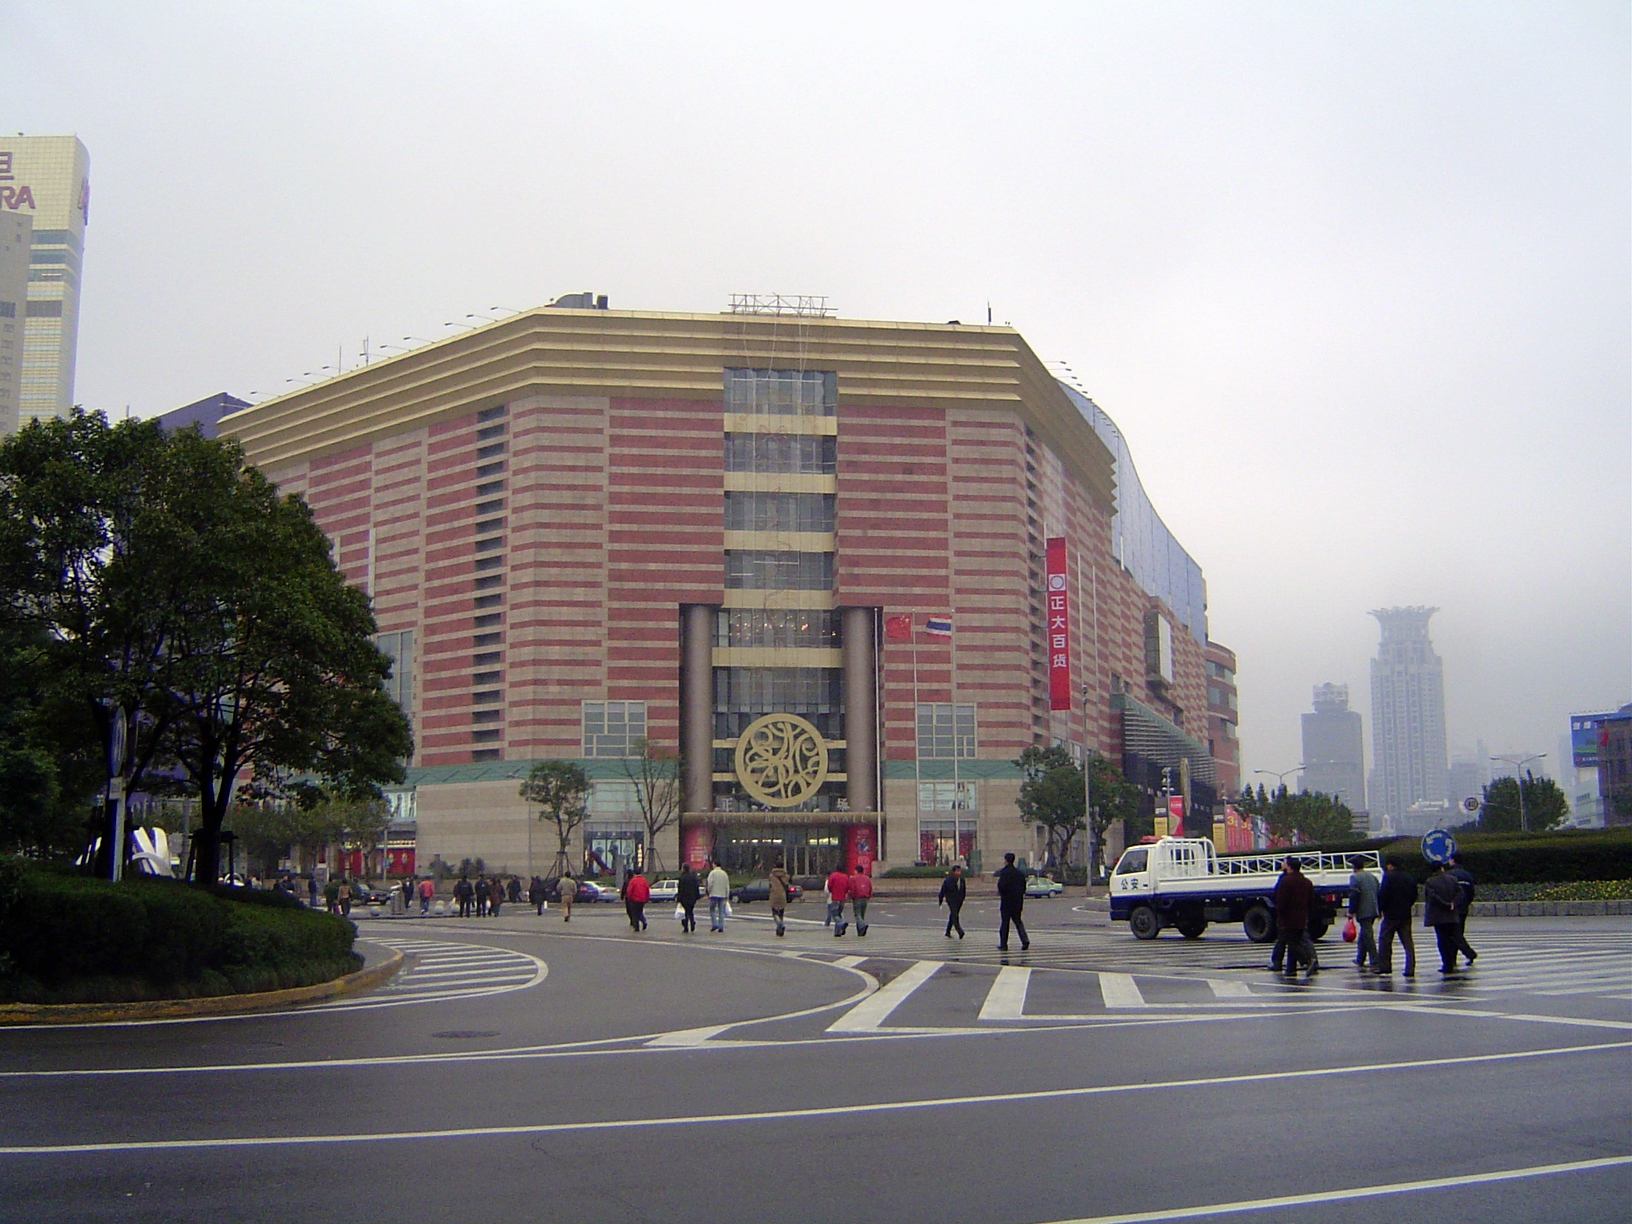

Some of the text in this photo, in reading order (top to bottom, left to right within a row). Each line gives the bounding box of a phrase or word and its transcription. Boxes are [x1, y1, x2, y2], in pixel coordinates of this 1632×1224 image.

[1051, 596, 1066, 667] 正大百货
[764, 814, 813, 824] BRAND
[829, 814, 867, 823] MALL
[1121, 878, 1139, 890] 公安
